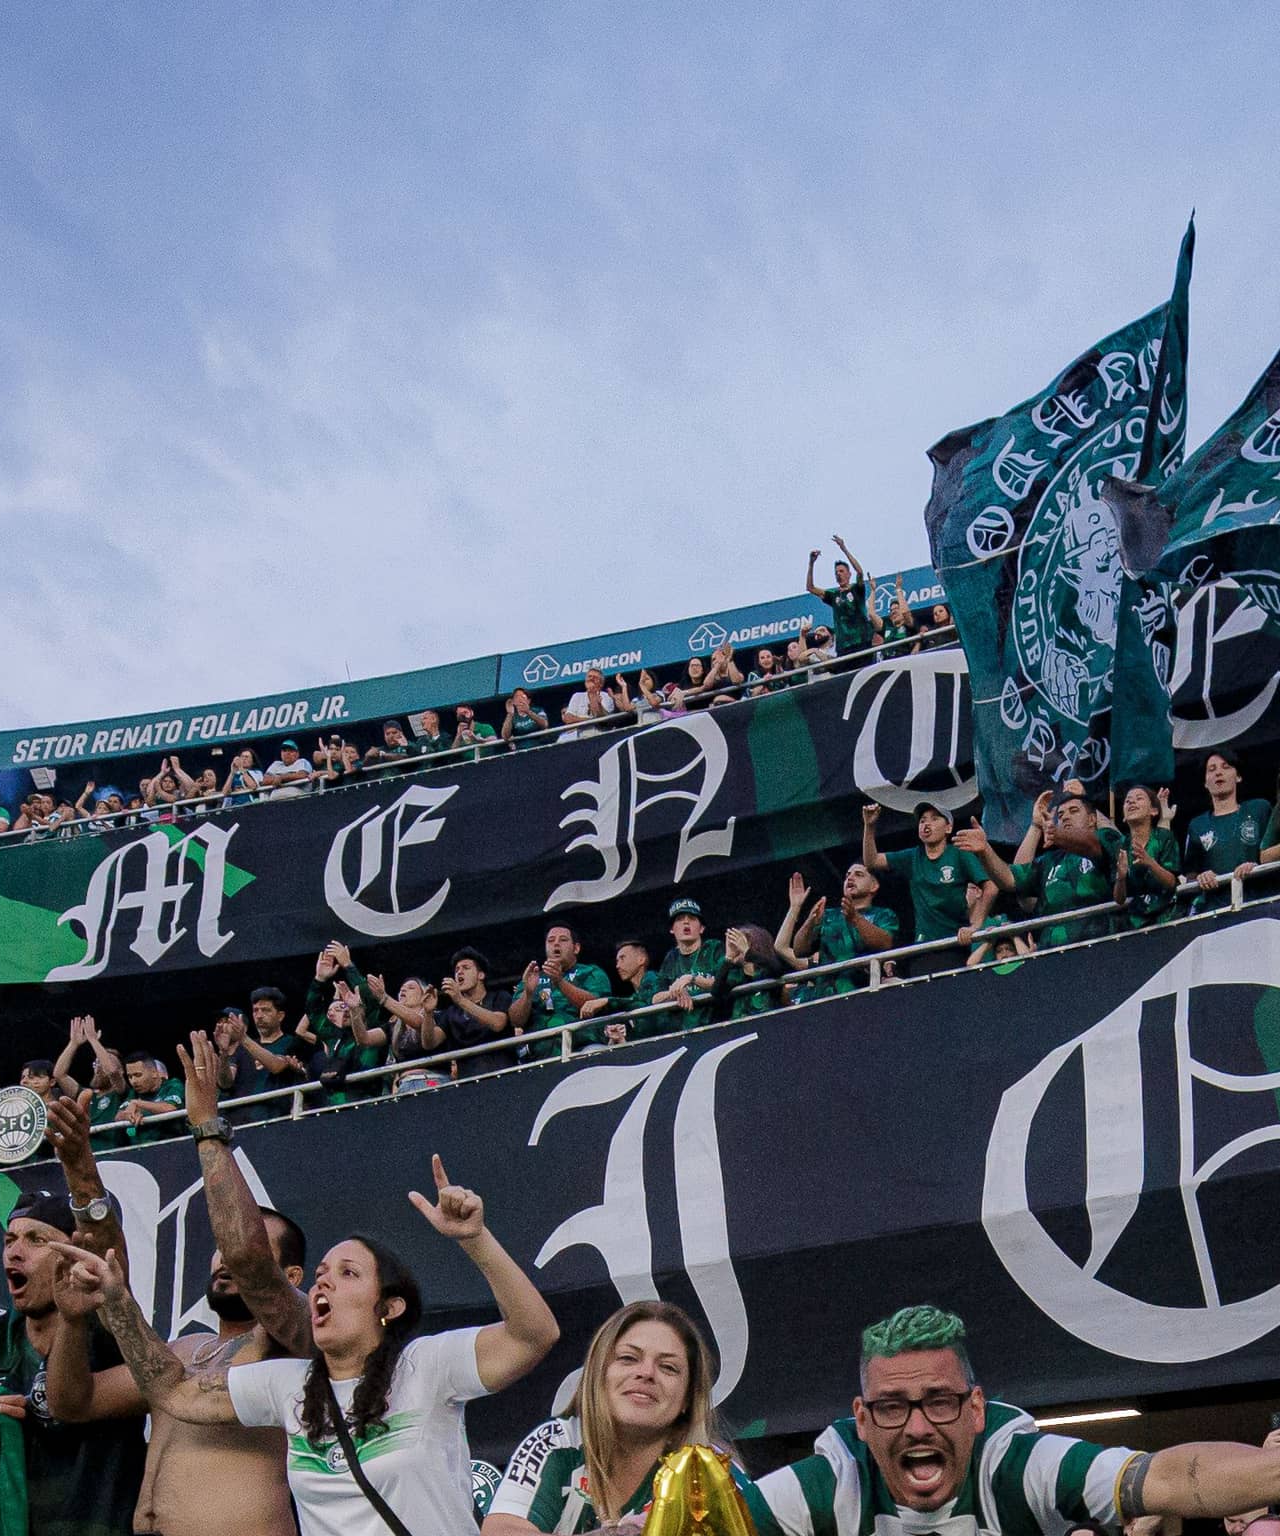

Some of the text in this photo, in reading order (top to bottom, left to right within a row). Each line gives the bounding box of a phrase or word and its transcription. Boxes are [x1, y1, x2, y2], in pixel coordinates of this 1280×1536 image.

[728, 614, 814, 645] ADEMICON
[12, 694, 351, 764] SETOR RENATO FOLLADOR JR.
